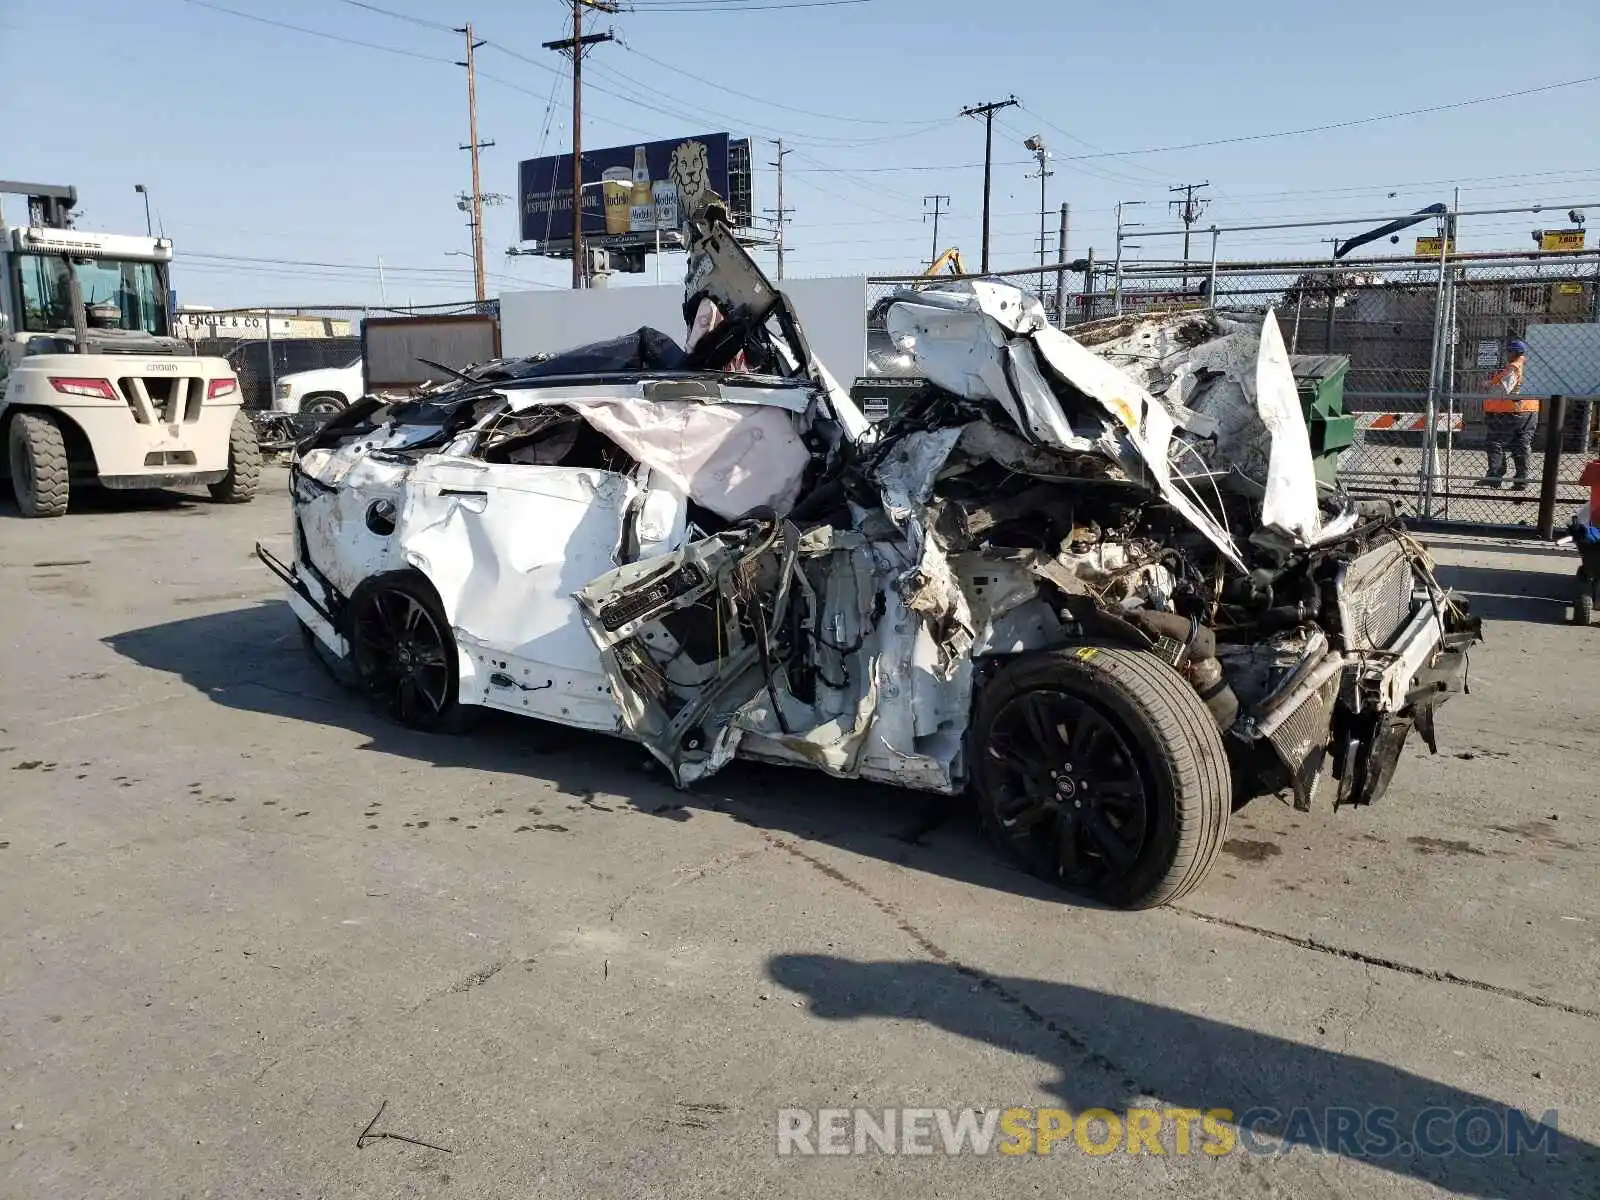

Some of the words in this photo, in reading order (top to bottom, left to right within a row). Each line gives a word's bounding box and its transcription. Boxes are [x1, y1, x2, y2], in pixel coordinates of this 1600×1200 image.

[188, 314, 227, 327] ENGLE
[231, 316, 238, 327] &
[244, 318, 263, 329] CO.
